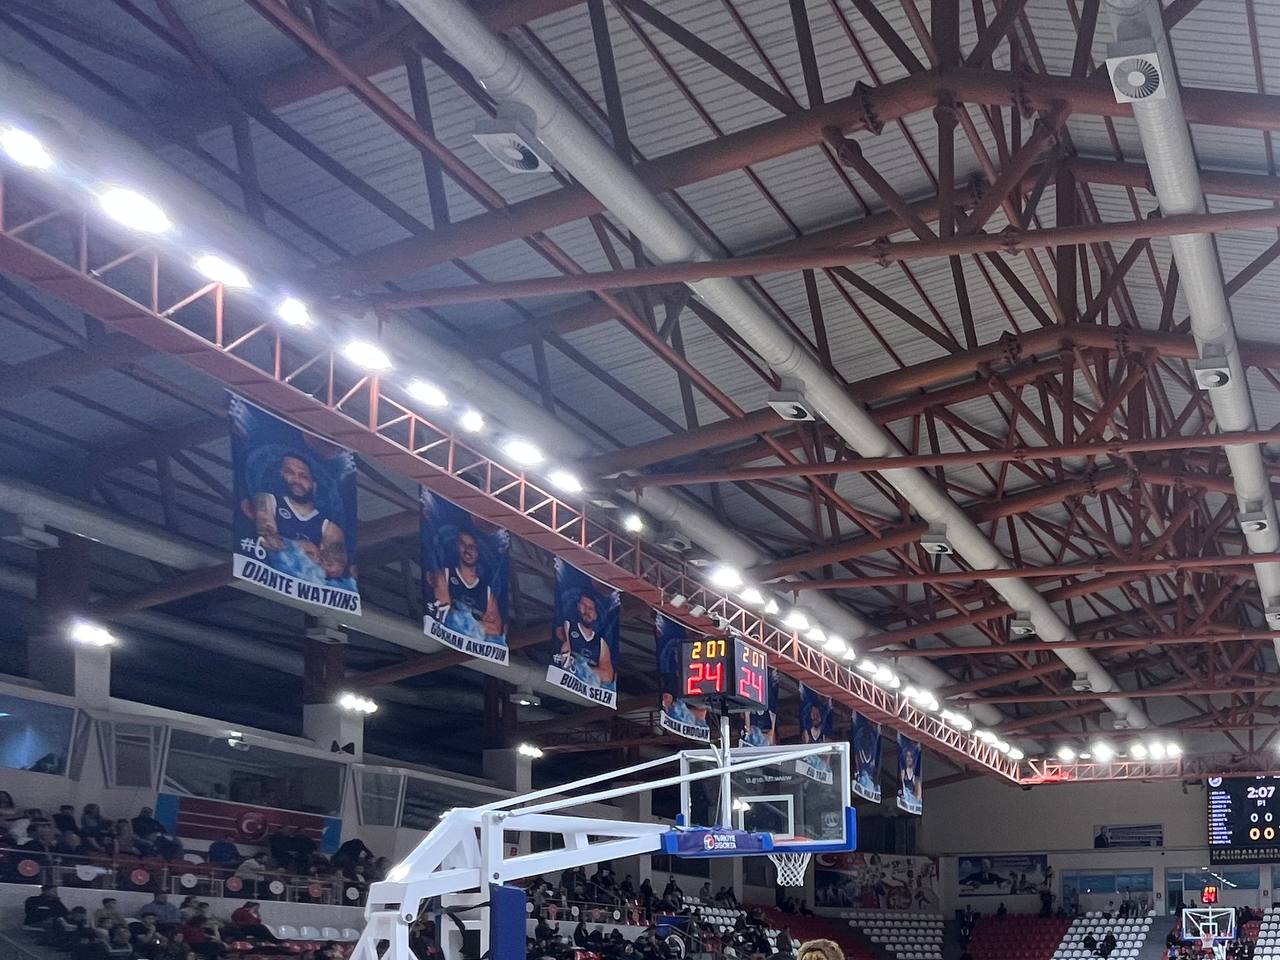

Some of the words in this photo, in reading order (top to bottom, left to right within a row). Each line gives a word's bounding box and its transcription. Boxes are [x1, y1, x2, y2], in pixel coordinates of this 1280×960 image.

[240, 536, 267, 560] #6
[242, 561, 294, 594] DIANTE
[297, 582, 358, 611] WATKINS
[560, 673, 587, 696] BURAK
[687, 661, 724, 695] 24
[739, 666, 764, 702] 24
[1247, 786, 1276, 799] 2:07
